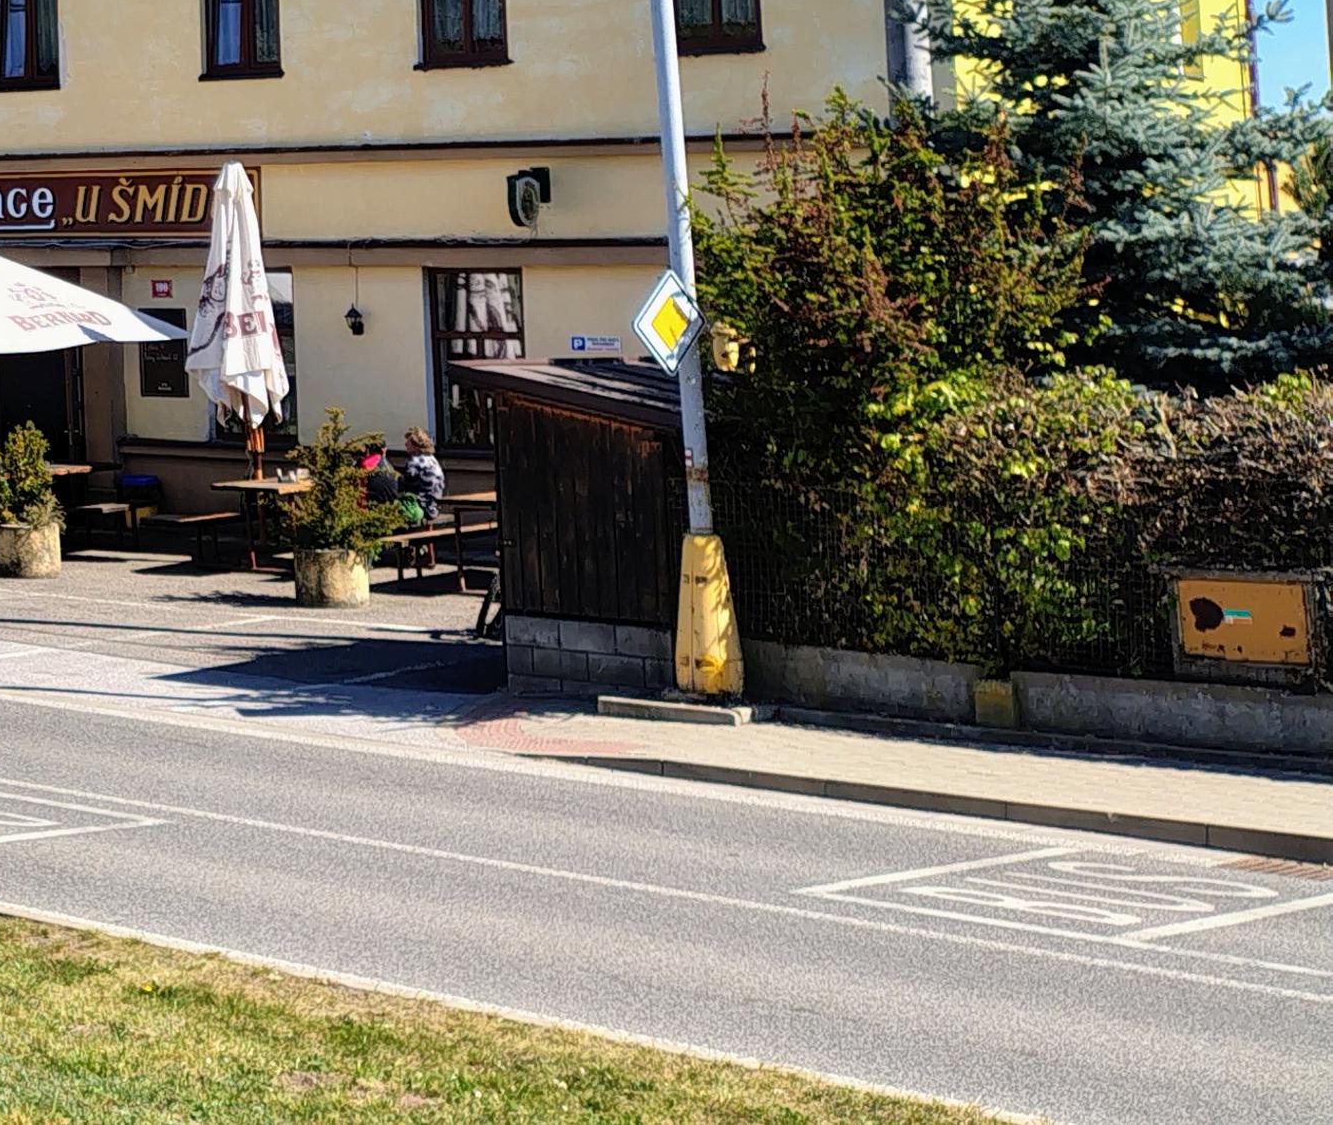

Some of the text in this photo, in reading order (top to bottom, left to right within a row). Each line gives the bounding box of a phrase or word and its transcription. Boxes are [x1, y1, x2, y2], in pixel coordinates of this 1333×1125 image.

[108, 175, 215, 224] ŠMÍD
[5, 311, 112, 331] BERNARD
[899, 861, 1280, 926] BUS
